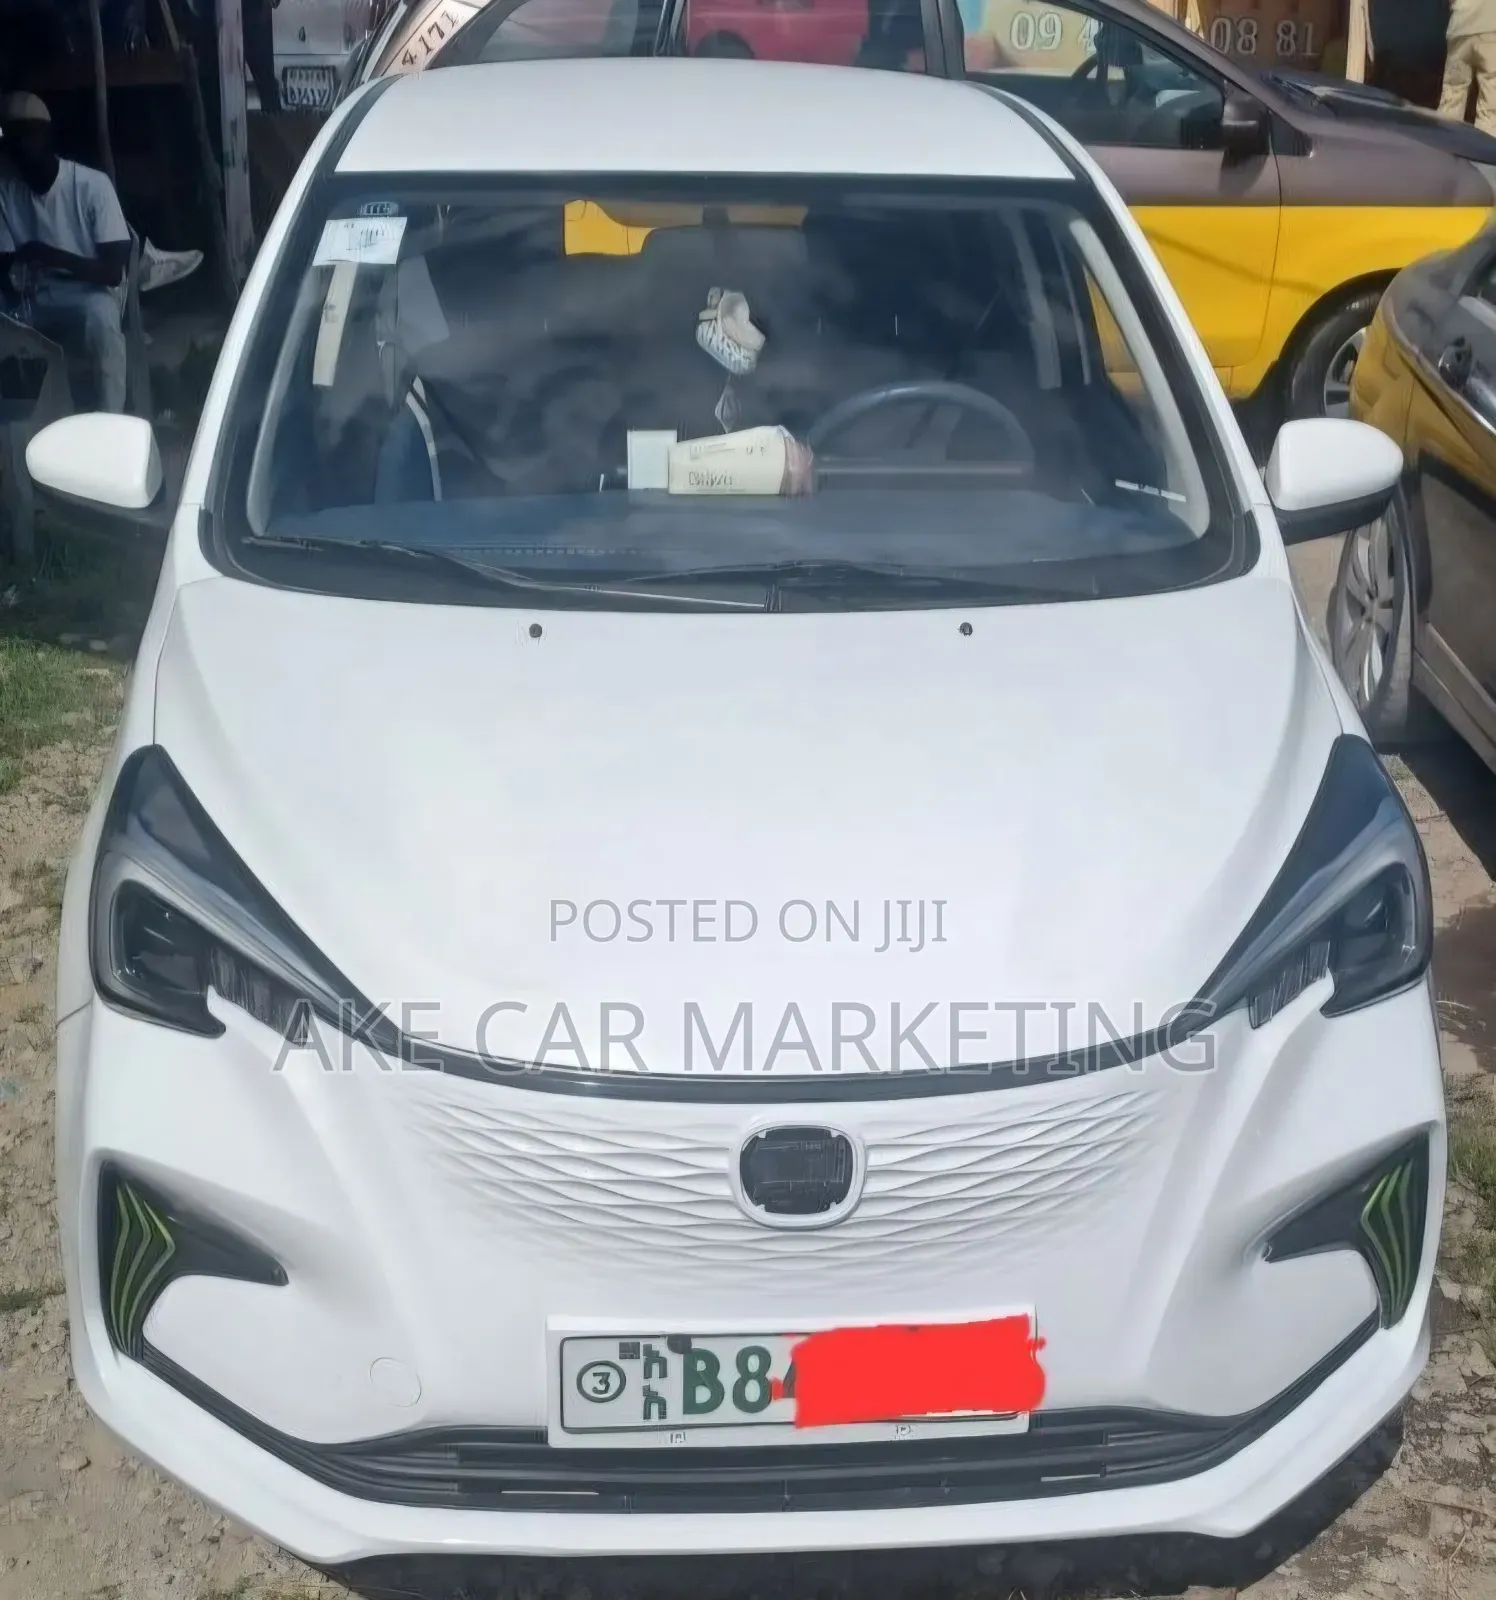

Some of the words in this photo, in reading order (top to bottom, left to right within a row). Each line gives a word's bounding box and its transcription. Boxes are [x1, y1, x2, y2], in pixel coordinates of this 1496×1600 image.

[1010, 11, 1063, 51] 09
[591, 1371, 611, 1395] 3
[683, 1345, 798, 1415] B8
